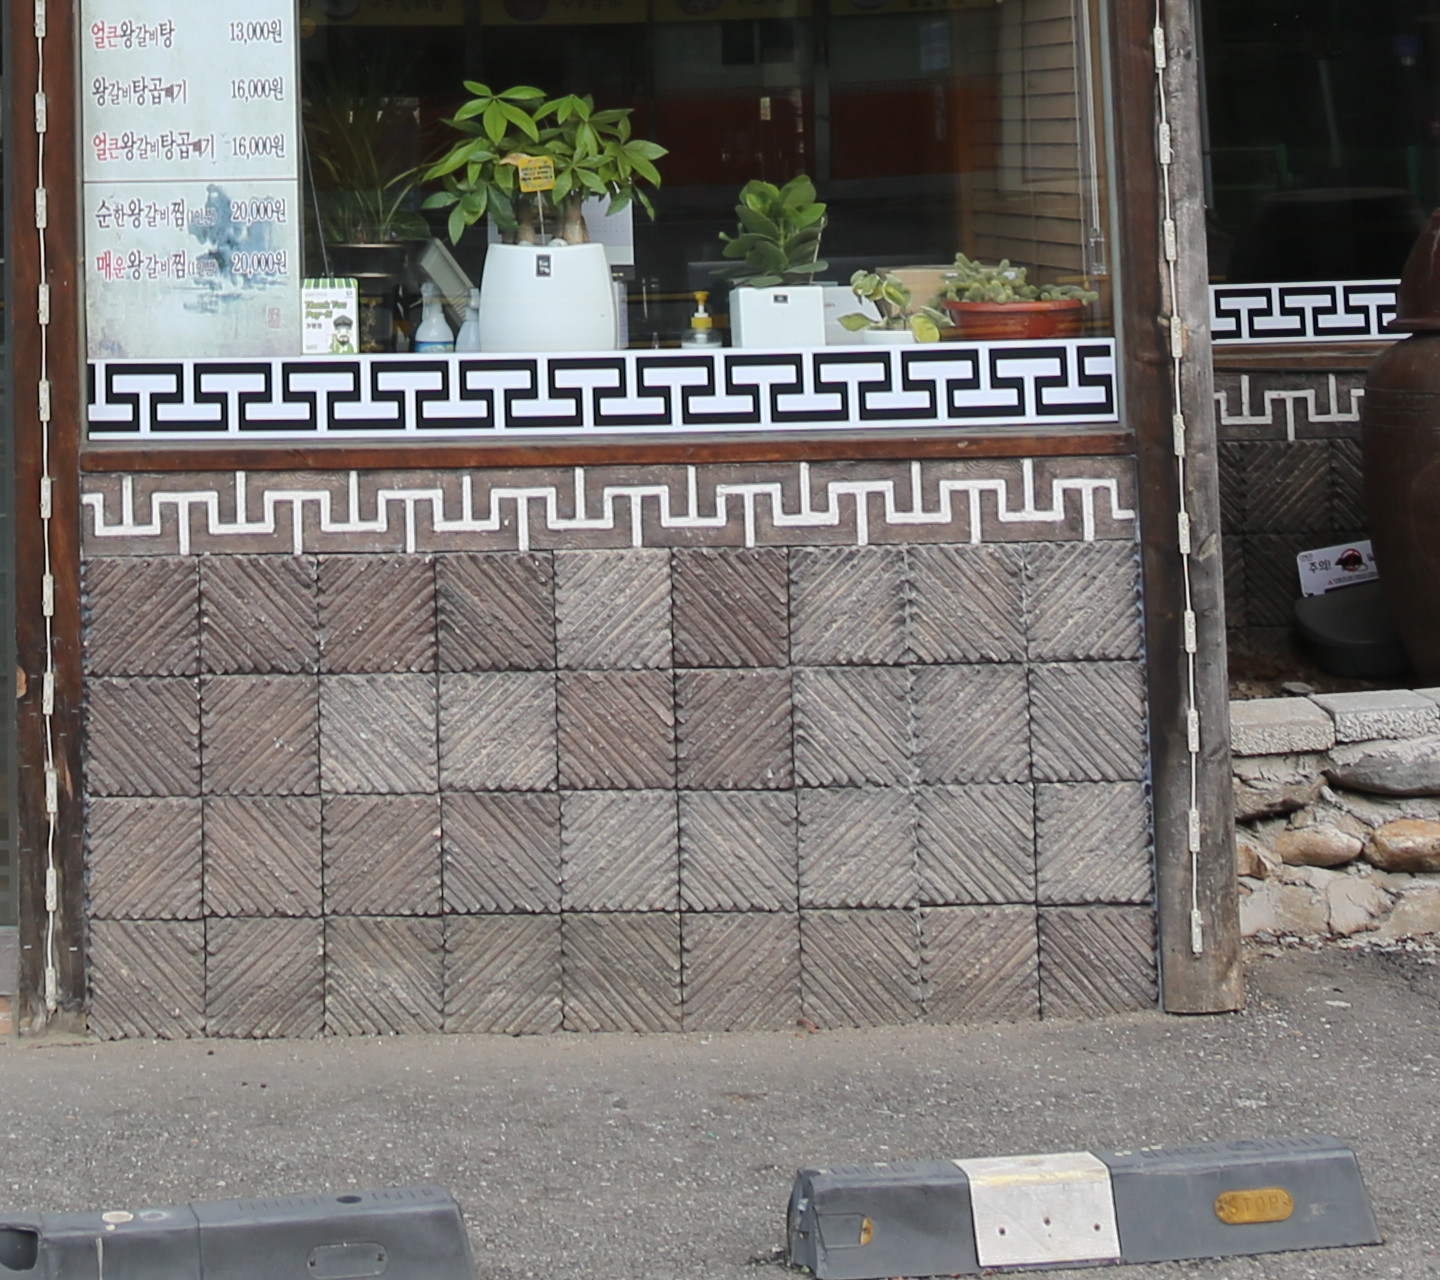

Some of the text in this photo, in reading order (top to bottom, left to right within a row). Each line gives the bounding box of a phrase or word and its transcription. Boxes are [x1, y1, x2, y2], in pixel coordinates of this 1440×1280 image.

[91, 18, 283, 49] 얼큰왕갈비탕 13,000원
[231, 76, 284, 103] 16,000원
[232, 133, 286, 159] 16,000원
[232, 198, 287, 223] 20,000원
[232, 251, 288, 276] 20,000원
